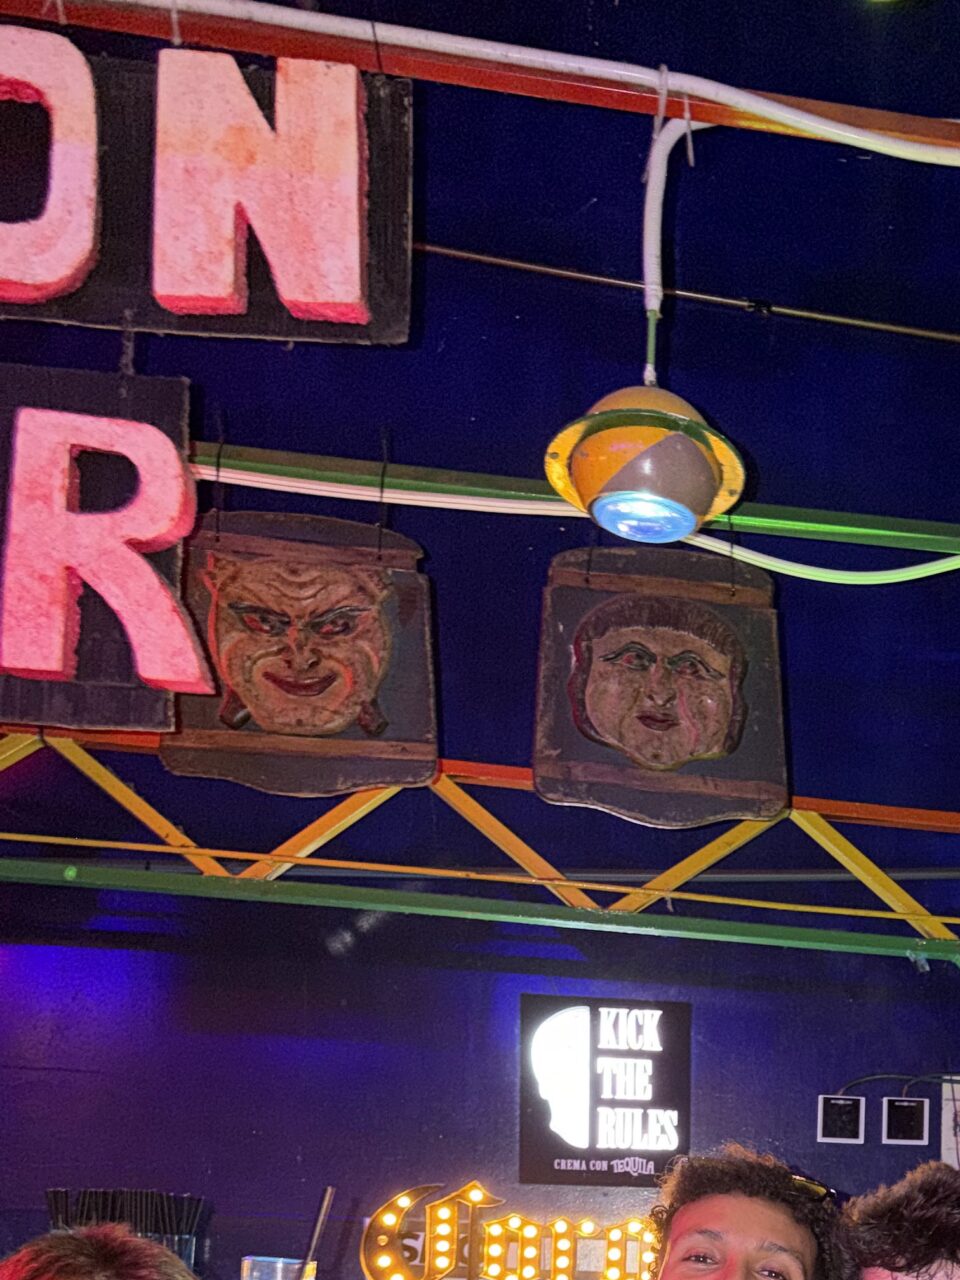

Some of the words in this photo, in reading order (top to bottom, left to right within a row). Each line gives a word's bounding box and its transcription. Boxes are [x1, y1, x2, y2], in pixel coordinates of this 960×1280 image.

[597, 1007, 663, 1051] KICK
[596, 1056, 653, 1100] THE
[596, 1106, 679, 1150] RULES
[553, 1158, 587, 1171] CREMA
[589, 1159, 608, 1171] CON
[610, 1157, 655, 1176] TEQUILA
